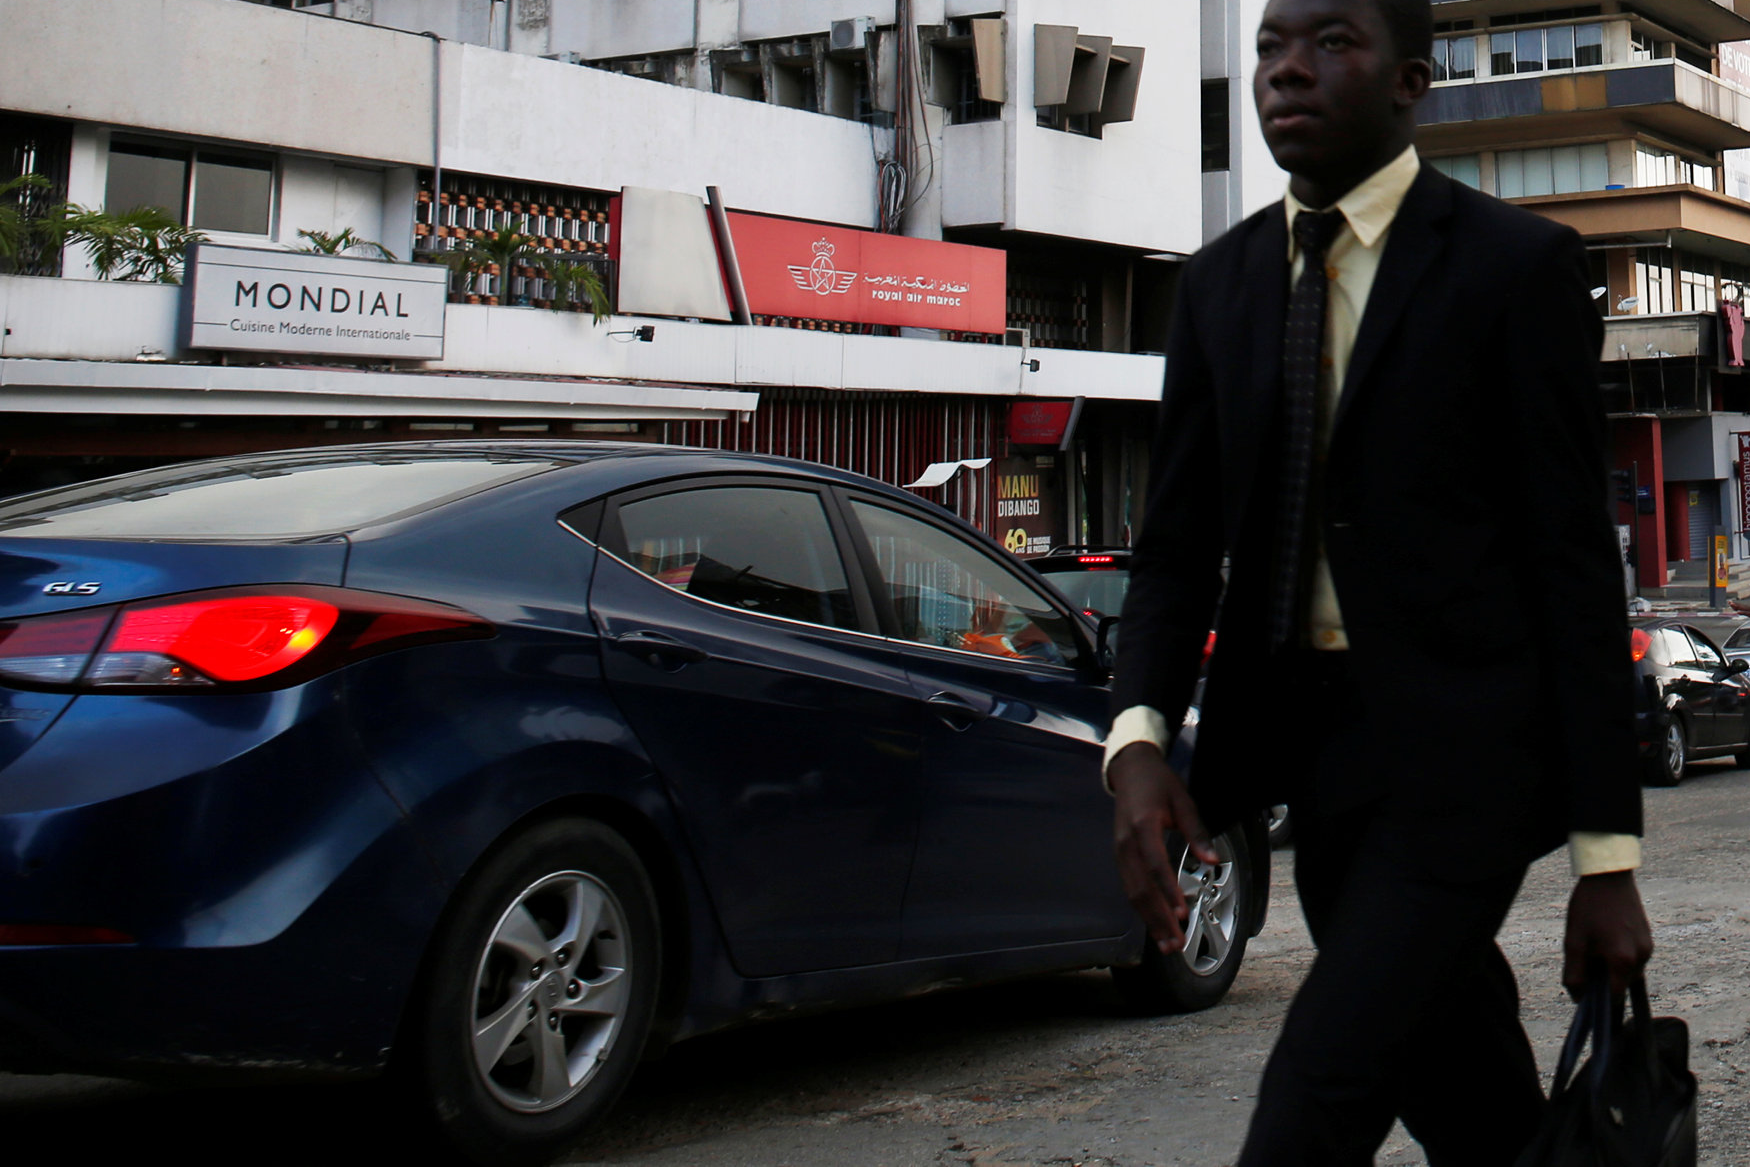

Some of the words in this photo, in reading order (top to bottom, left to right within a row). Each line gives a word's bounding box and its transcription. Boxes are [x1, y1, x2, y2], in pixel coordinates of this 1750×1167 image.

[234, 280, 409, 318] MONDIAL
[872, 289, 902, 301] royal
[906, 291, 922, 303] air
[926, 294, 961, 306] maroc
[230, 318, 276, 333] Cuisine
[279, 321, 332, 337] Moderne
[336, 325, 411, 341] Internationale
[997, 474, 1040, 498] MANU
[997, 499, 1040, 517] DIBANGO
[1004, 528, 1028, 554] 60
